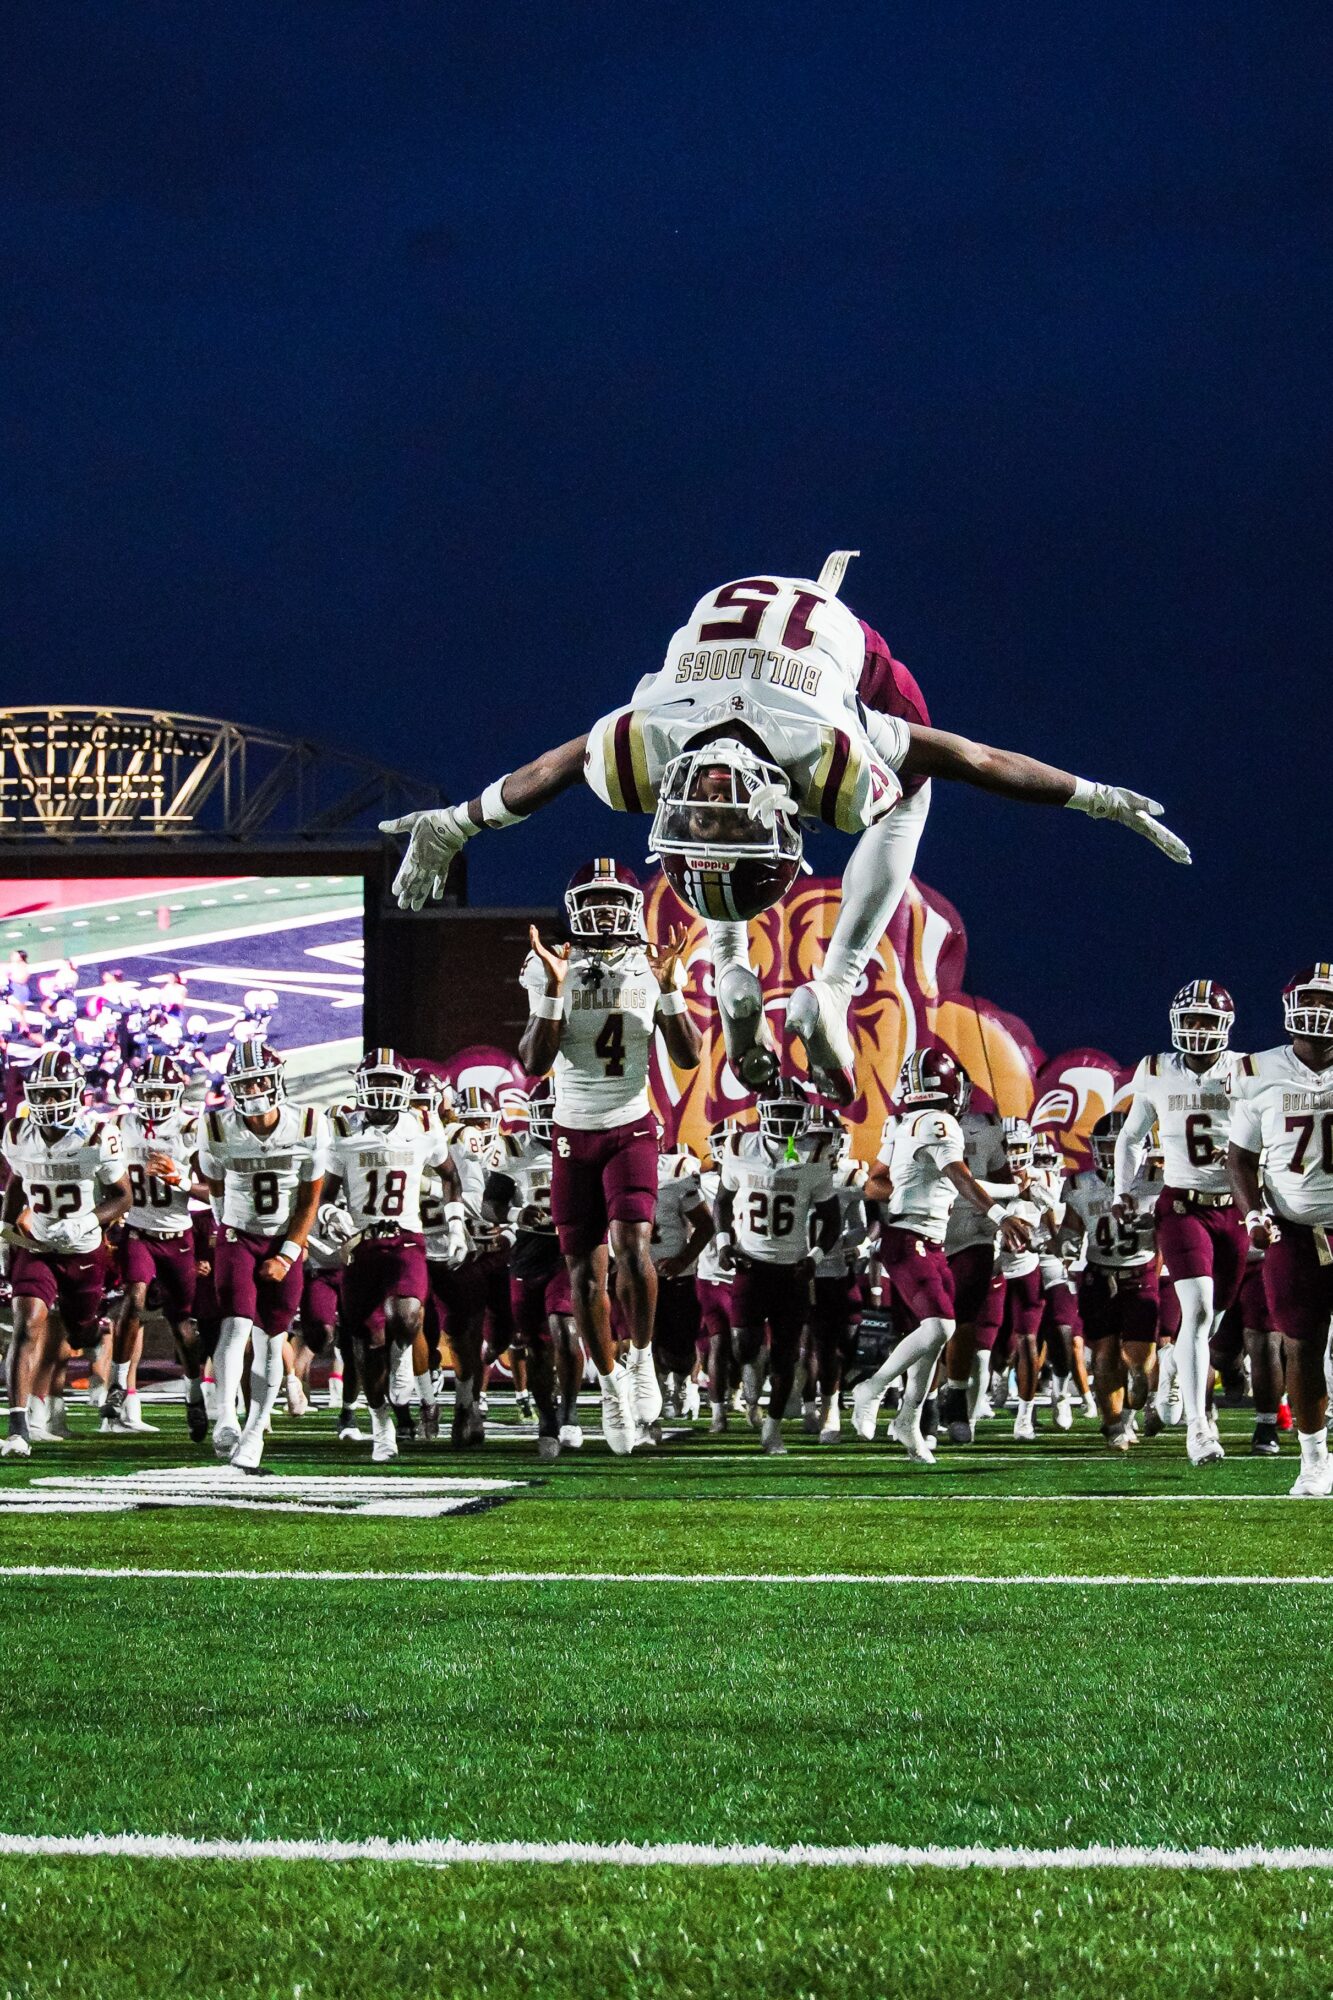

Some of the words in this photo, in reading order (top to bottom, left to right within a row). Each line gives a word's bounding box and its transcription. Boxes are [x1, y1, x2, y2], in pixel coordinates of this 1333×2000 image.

[697, 579, 828, 652] 15
[675, 648, 822, 696] BULLDOGS
[690, 860, 730, 872] Riddell
[571, 987, 647, 1010] BULLDOGS
[595, 1013, 626, 1077] 4
[933, 1120, 947, 1138] 3
[1186, 1114, 1214, 1167] 6
[30, 1183, 82, 1220] 22
[253, 1171, 279, 1215] 8
[361, 1169, 408, 1217] 18
[748, 1191, 796, 1238] 26
